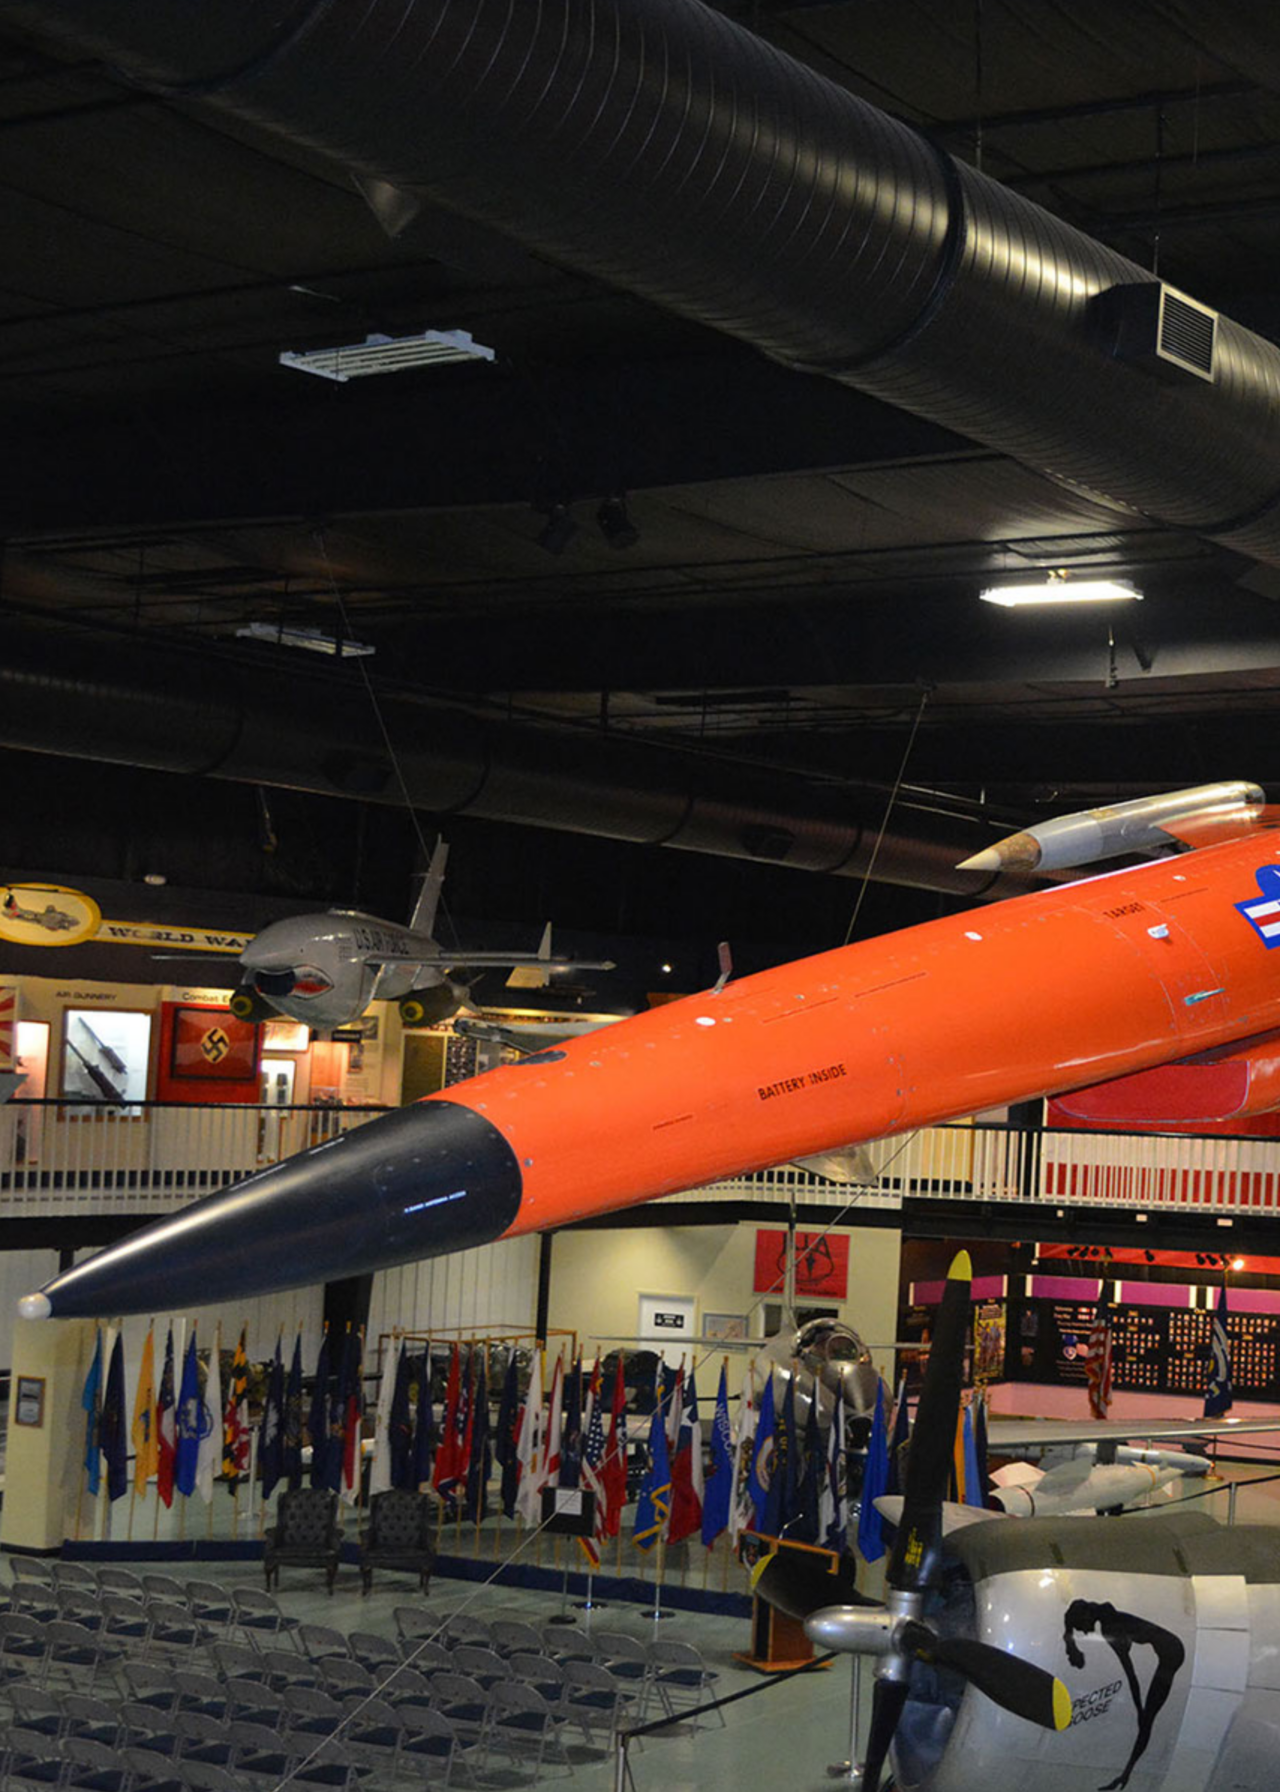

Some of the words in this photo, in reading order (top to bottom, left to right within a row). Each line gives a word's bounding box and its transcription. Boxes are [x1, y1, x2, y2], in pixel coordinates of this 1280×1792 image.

[758, 1076, 806, 1101] BATTERY
[808, 1064, 848, 1085] INSIDE
[1072, 1680, 1122, 1711] PECTED
[1072, 1699, 1113, 1725] OOSE
